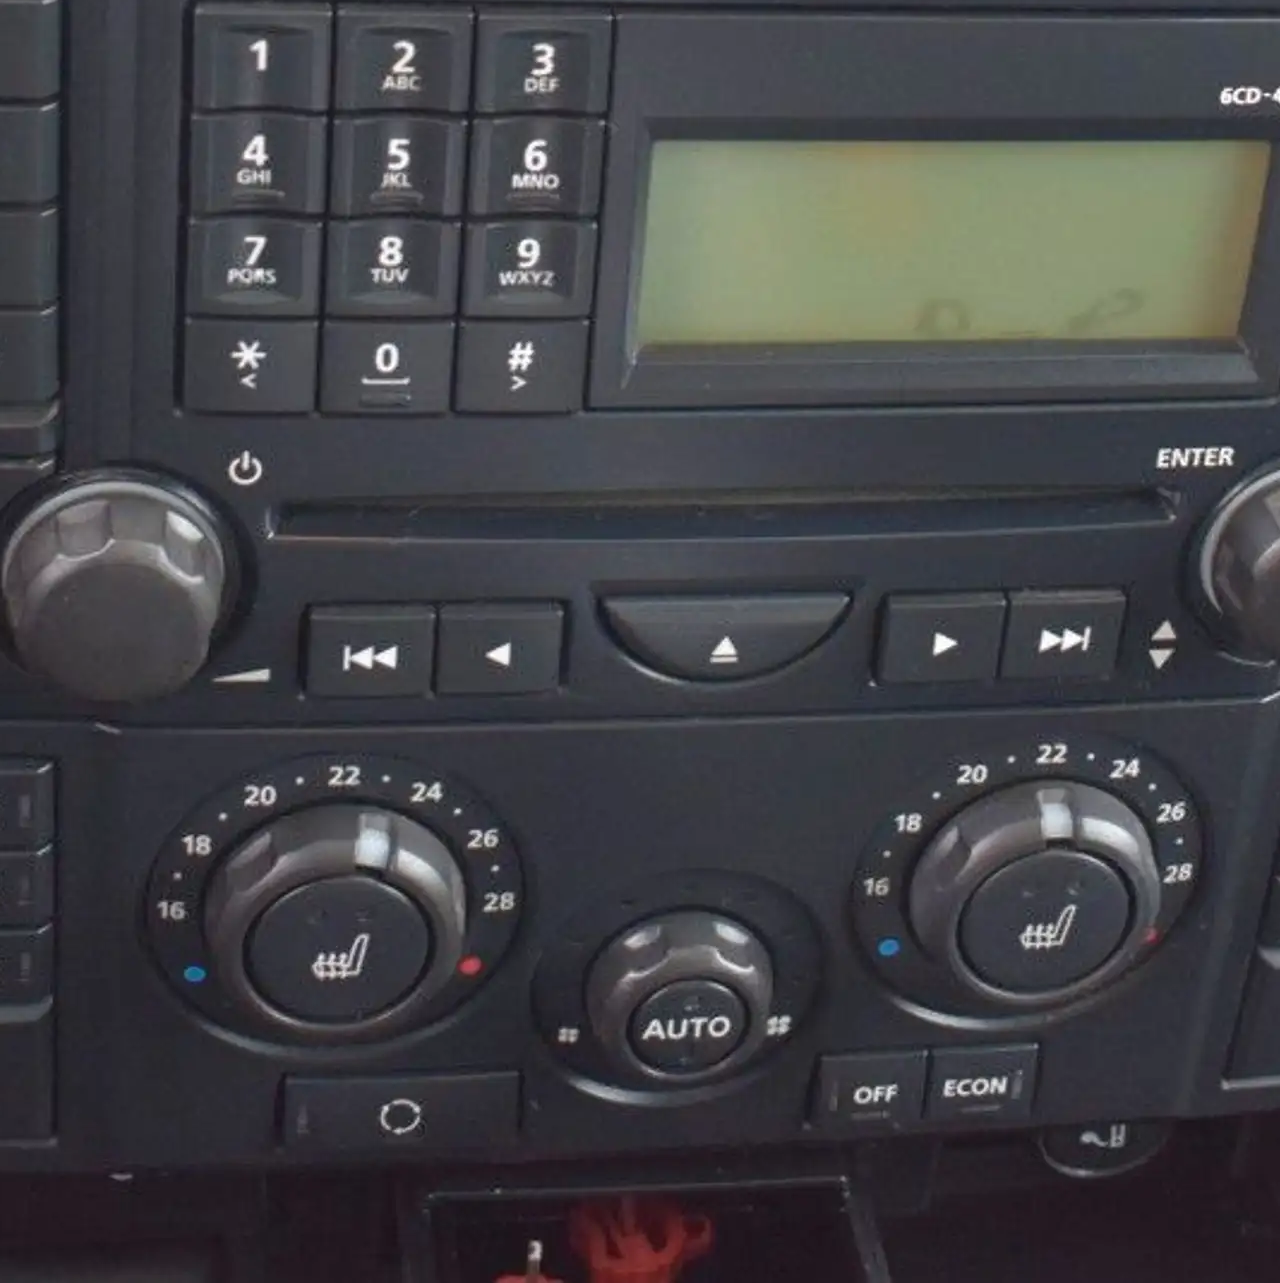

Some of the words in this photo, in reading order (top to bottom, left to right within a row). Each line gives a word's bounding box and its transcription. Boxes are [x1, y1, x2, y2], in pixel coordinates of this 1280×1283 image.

[250, 39, 267, 71] 1
[392, 40, 415, 74] 2
[531, 43, 555, 76] 3
[382, 76, 420, 91] ABC
[524, 77, 559, 92] DEF
[242, 135, 269, 167] 4
[387, 138, 410, 171] 5
[524, 139, 548, 172] 6
[236, 168, 271, 185] GHI
[382, 173, 410, 187] JKL
[512, 173, 559, 189] MNO
[244, 236, 266, 266] 7
[379, 236, 403, 266] 8
[517, 238, 540, 269] 9
[371, 267, 409, 283] TUV
[499, 271, 553, 286] WXYZ
[375, 343, 399, 373] 0
[1157, 447, 1234, 468] ENTER
[1036, 743, 1067, 764] 22
[328, 765, 360, 786] 22
[956, 764, 988, 784] 20
[1109, 758, 1140, 779] 24
[244, 785, 277, 806] 20
[411, 782, 443, 802] 24
[895, 813, 922, 832] 18
[1156, 801, 1185, 823] 26
[183, 834, 211, 855] 18
[467, 829, 499, 848] 26
[1163, 862, 1193, 884] 28
[863, 877, 889, 896] 16
[157, 901, 186, 920] 16
[483, 892, 514, 912] 28
[642, 1015, 731, 1040] AUTO
[853, 1083, 898, 1104] OFF
[943, 1076, 1008, 1097] ECON
